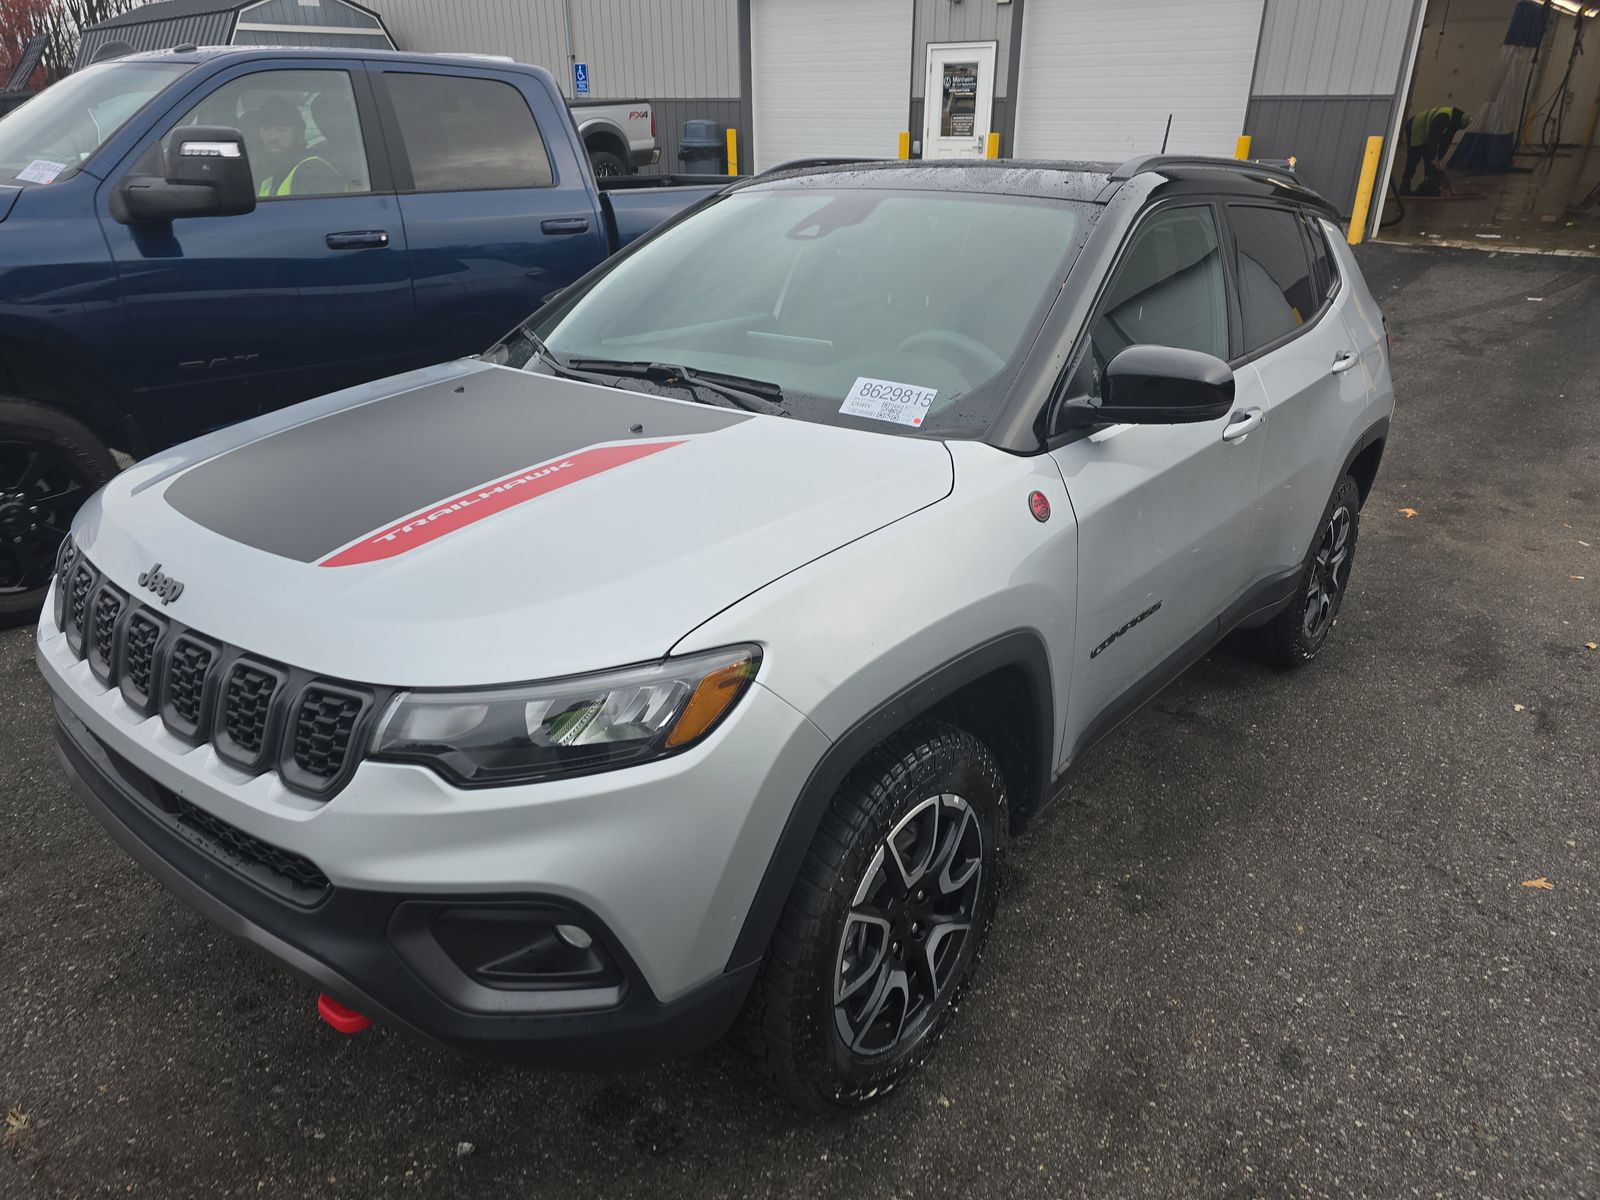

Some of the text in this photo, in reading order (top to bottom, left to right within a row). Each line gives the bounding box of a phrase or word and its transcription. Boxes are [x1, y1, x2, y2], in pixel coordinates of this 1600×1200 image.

[629, 111, 648, 120] FX4
[860, 382, 935, 408] 8629815
[372, 459, 576, 544] TRAILHAWK
[138, 562, 185, 606] Jeep
